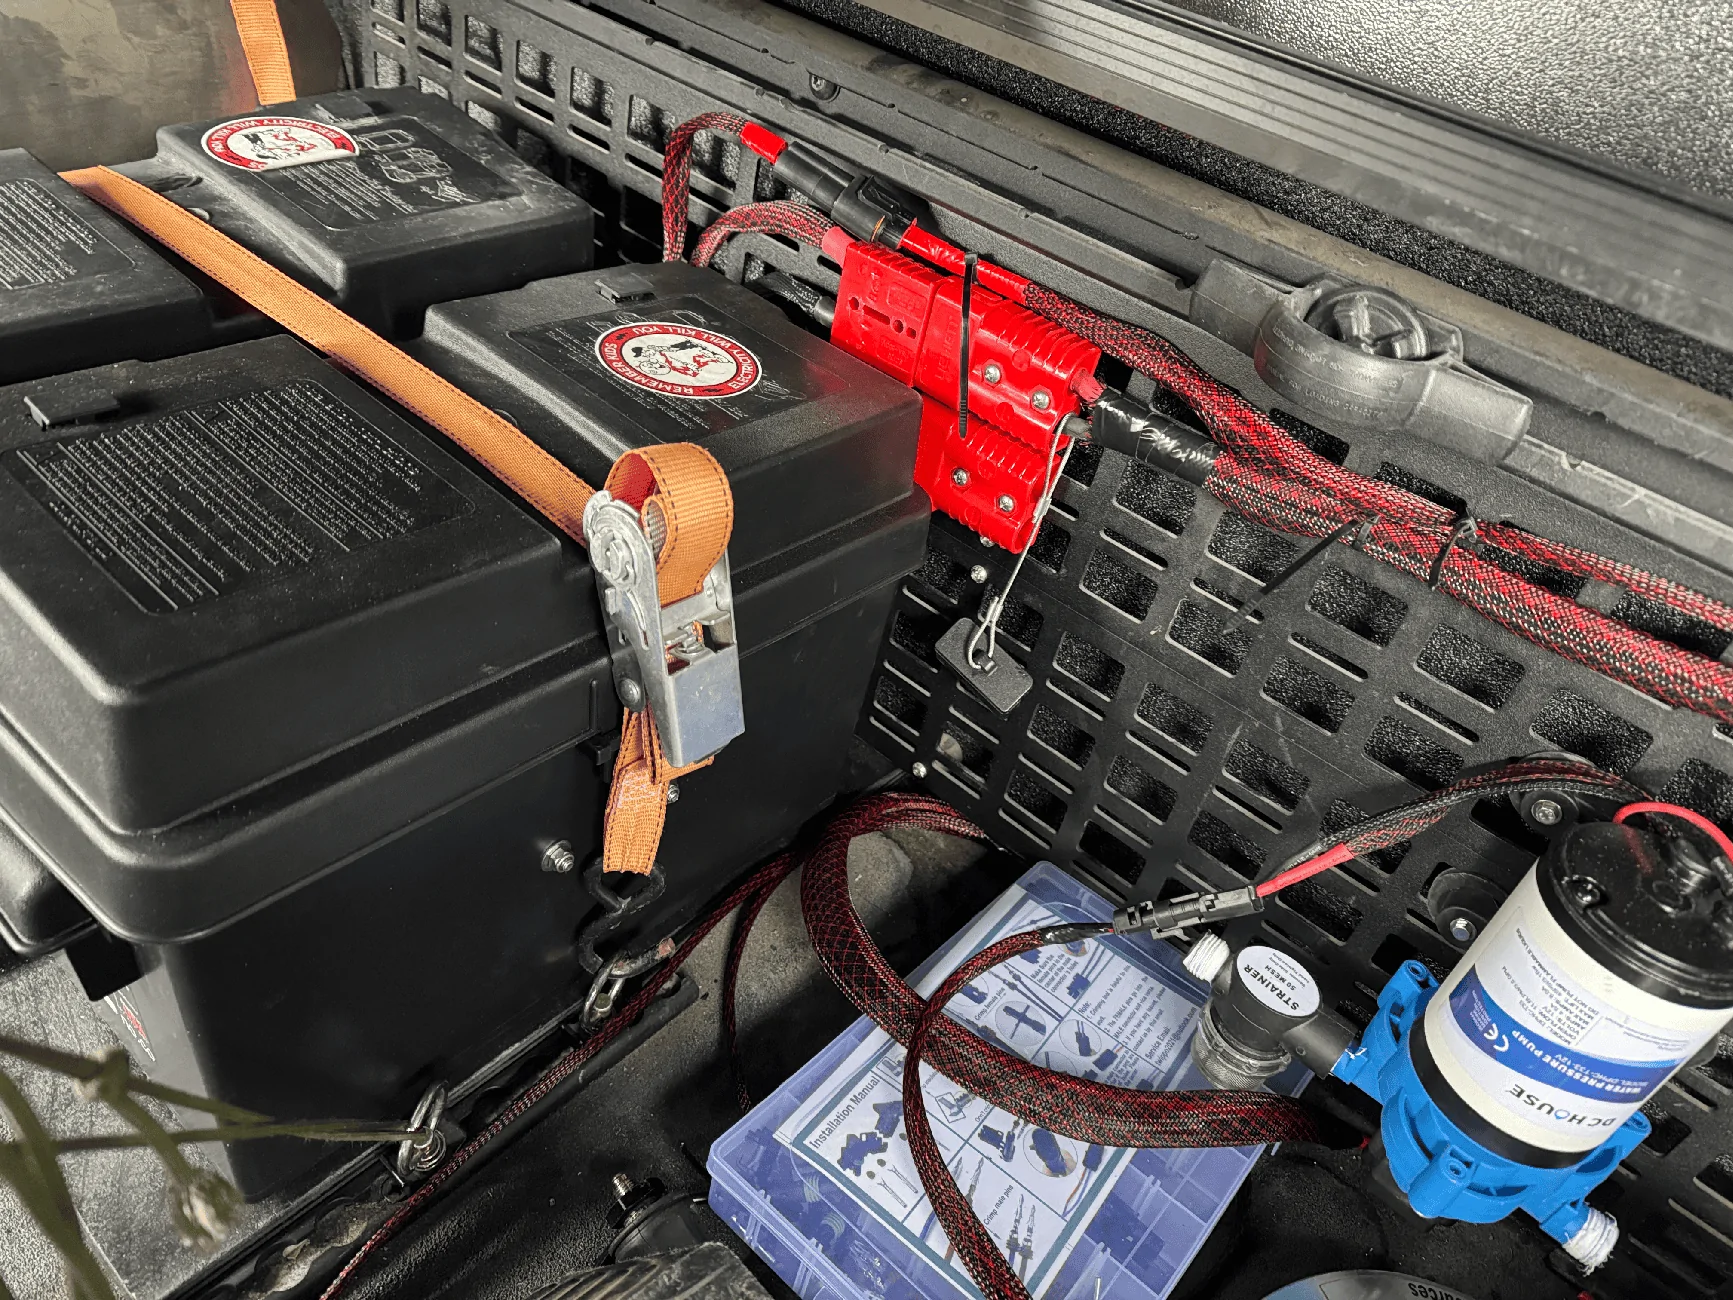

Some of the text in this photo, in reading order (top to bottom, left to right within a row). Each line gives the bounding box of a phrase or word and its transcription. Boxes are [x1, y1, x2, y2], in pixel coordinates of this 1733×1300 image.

[211, 126, 229, 142] KILL
[229, 119, 259, 132] WILL
[263, 119, 340, 139] ELECTRICITY
[604, 342, 694, 394] REMEMBER KIDS
[632, 326, 754, 389] ELECTRICITY WILL KILL YOU
[1264, 964, 1296, 991] 50 MESH
[1527, 948, 1557, 983] FLAMMABLE
[1244, 964, 1300, 1010] STRAINER
[1484, 1023, 1509, 1052] CE
[1558, 1024, 1576, 1040] OPEN
[1512, 1030, 1642, 1094] WATER PRESSURE PUMP
[809, 1073, 880, 1150] Installation Manual
[982, 1207, 999, 1225] Crimp
[1001, 1183, 1014, 1197] pins
[1408, 1282, 1462, 1300] urces
